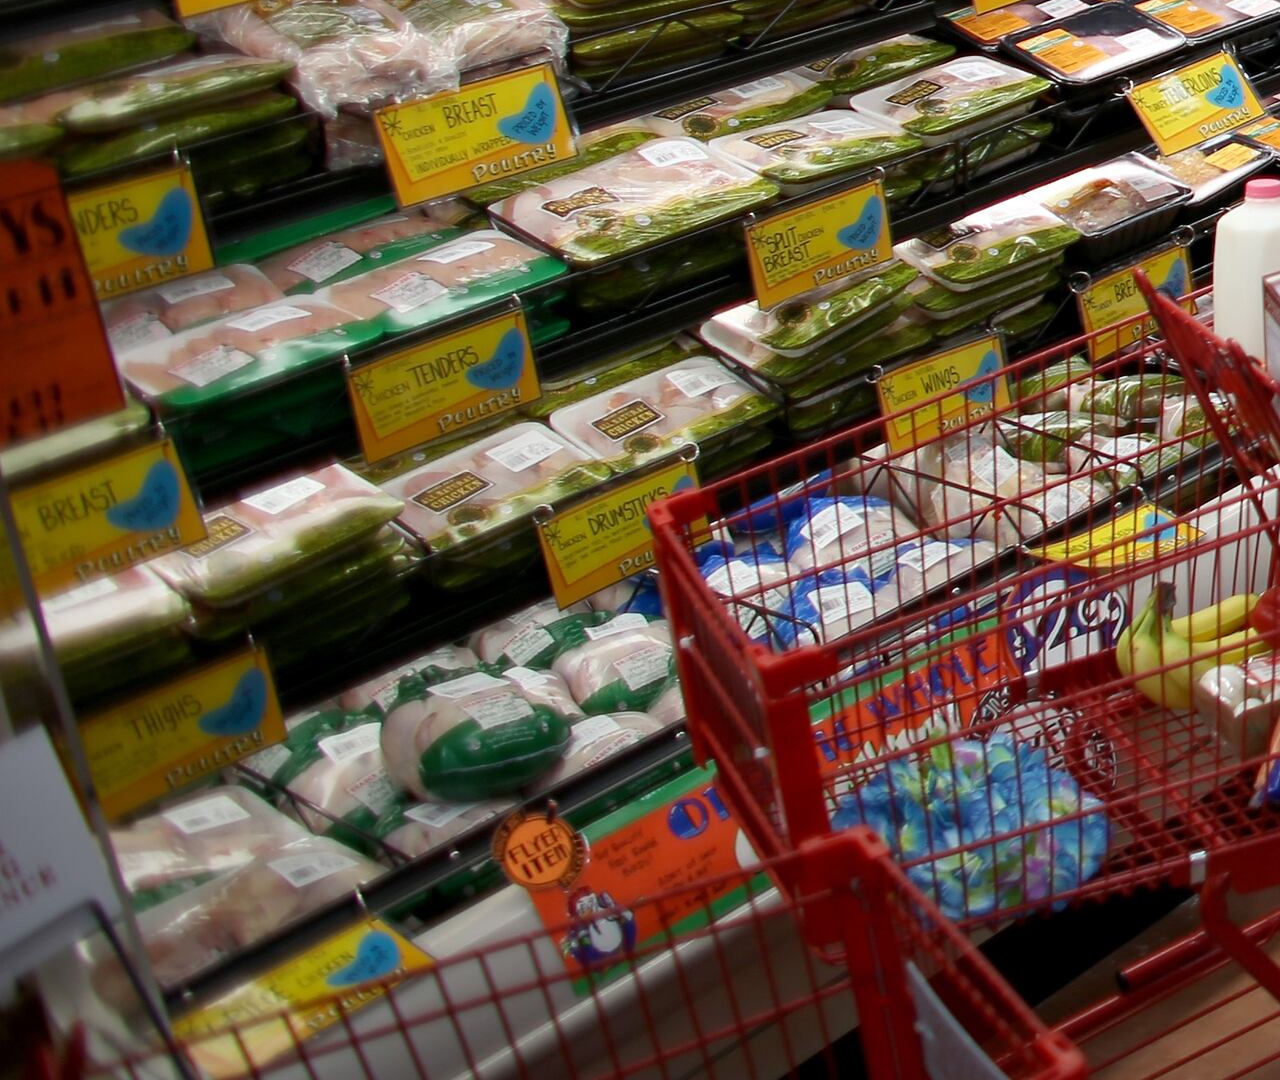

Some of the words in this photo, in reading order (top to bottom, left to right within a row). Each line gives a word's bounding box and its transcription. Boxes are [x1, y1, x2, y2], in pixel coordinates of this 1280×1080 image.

[1161, 67, 1224, 106] TENDERLOINS
[402, 123, 436, 141] CHICKEN
[442, 92, 499, 129] BREAST
[512, 109, 537, 135] PRICED
[1199, 106, 1252, 138] POULTRY
[415, 149, 469, 174] INDIVIDUALLY
[473, 134, 511, 156] WRAPPED
[471, 142, 557, 182] POULTRY
[76, 197, 139, 236] NDERS
[763, 240, 811, 273] BREAST
[766, 226, 797, 254] SPLIT
[813, 248, 879, 287] POULTRY
[407, 345, 480, 388] TENDERS
[920, 365, 961, 395] WINGS
[438, 387, 521, 434] POULTRY
[607, 409, 655, 438] CHICKEN
[38, 480, 120, 533] BREAST
[430, 479, 483, 512] CHICKEN
[587, 486, 669, 536] DRUMSTICKS
[76, 526, 181, 582] POULTRY
[128, 693, 203, 740] THIGHS
[165, 729, 264, 789] POULTRY
[520, 844, 569, 880] ITEM
